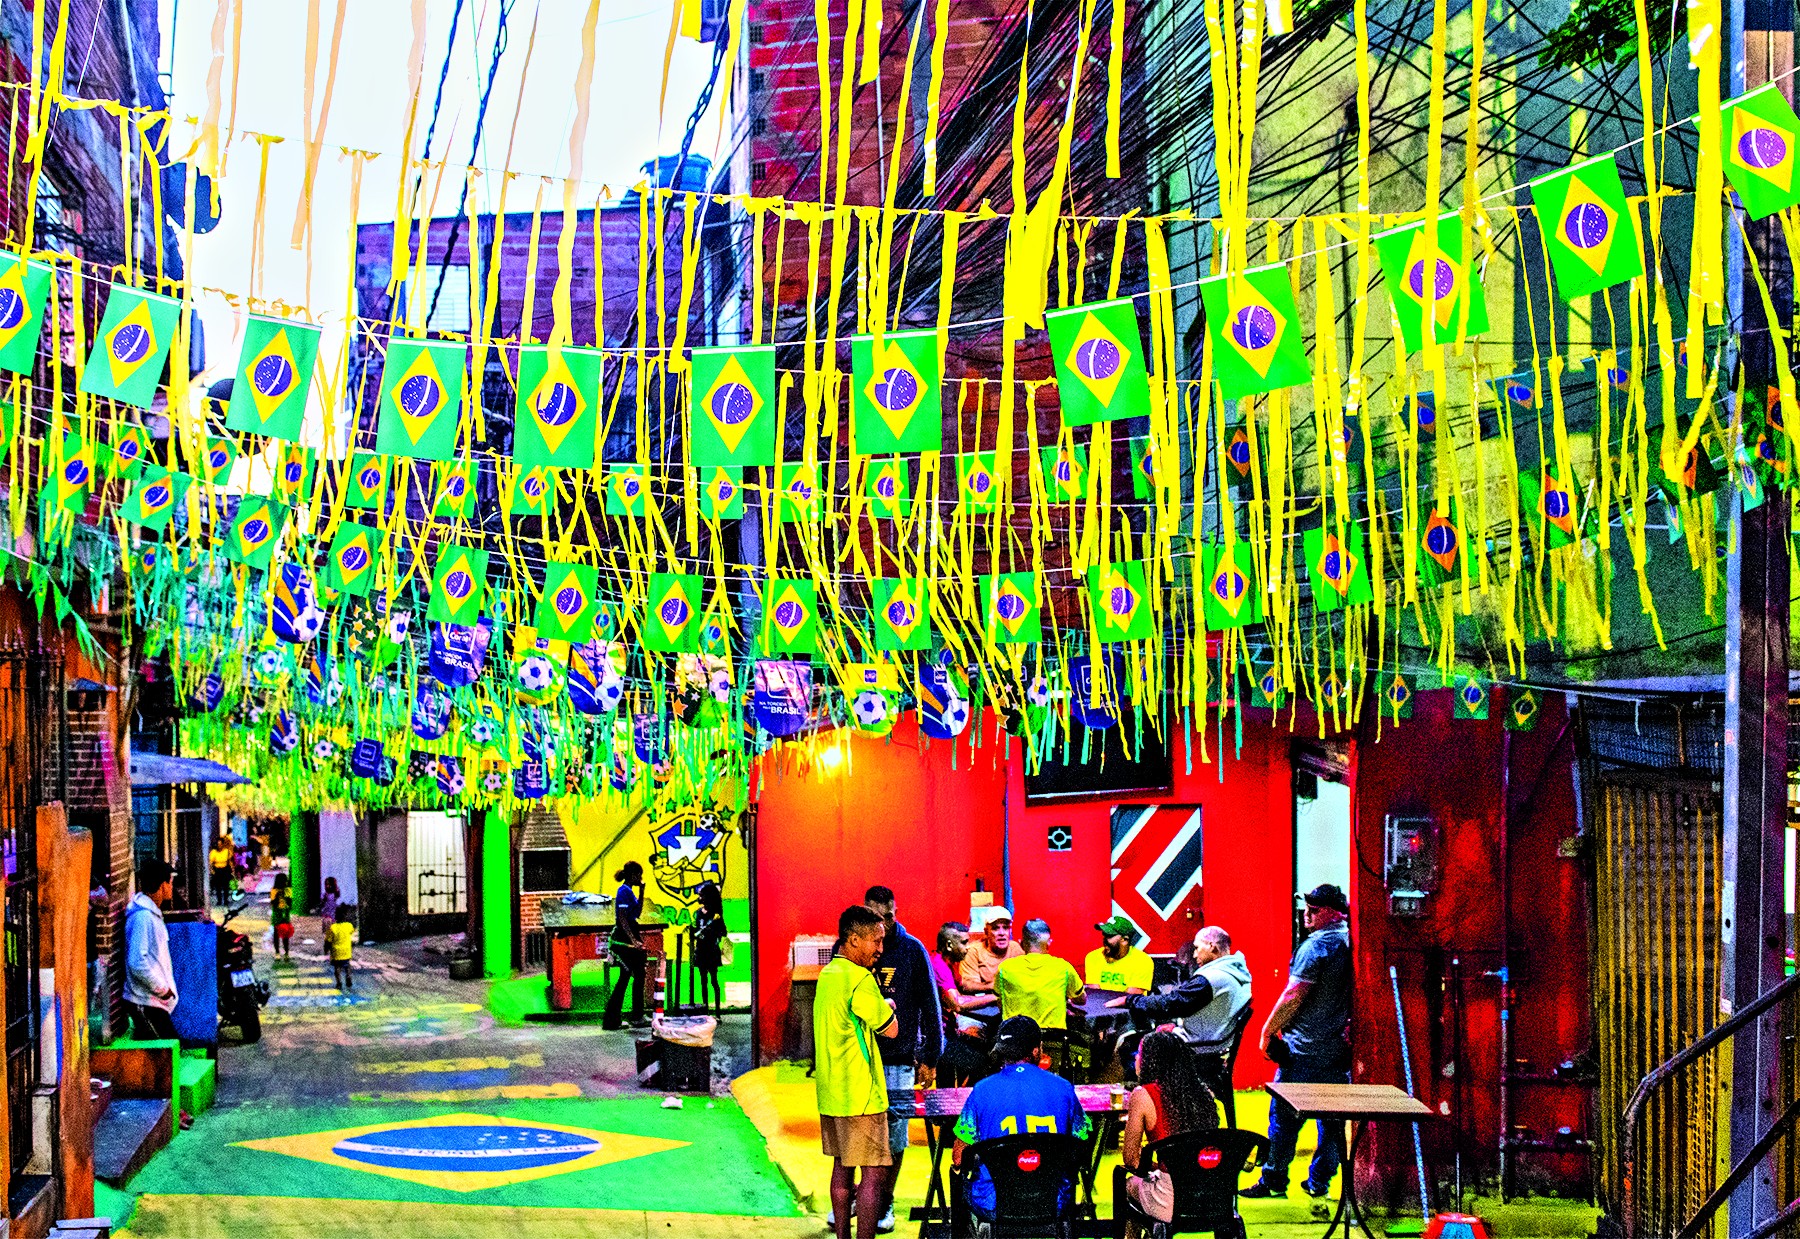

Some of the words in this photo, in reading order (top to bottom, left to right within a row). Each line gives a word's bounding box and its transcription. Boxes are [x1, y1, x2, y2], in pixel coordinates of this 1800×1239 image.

[445, 656, 474, 671] BRASIL
[771, 706, 802, 715] BRASIL
[1101, 971, 1127, 986] BRASIL
